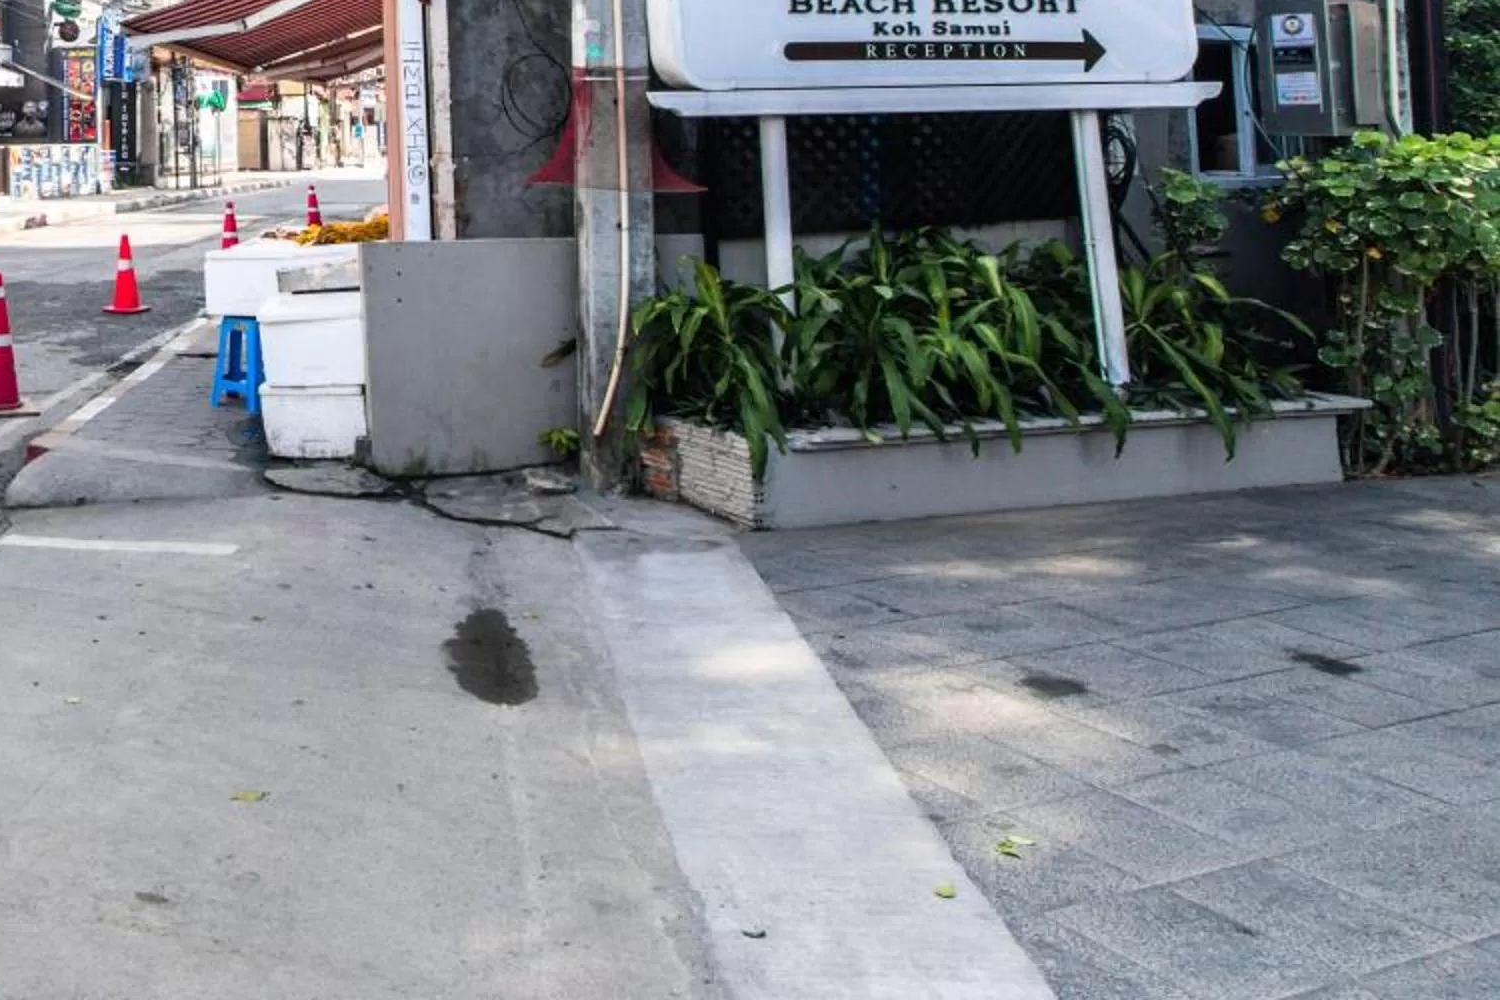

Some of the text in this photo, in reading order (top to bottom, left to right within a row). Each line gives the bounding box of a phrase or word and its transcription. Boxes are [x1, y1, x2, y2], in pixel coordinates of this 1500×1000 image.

[873, 21, 1011, 36] Koh Samui
[866, 43, 1027, 58] RECEPTION
